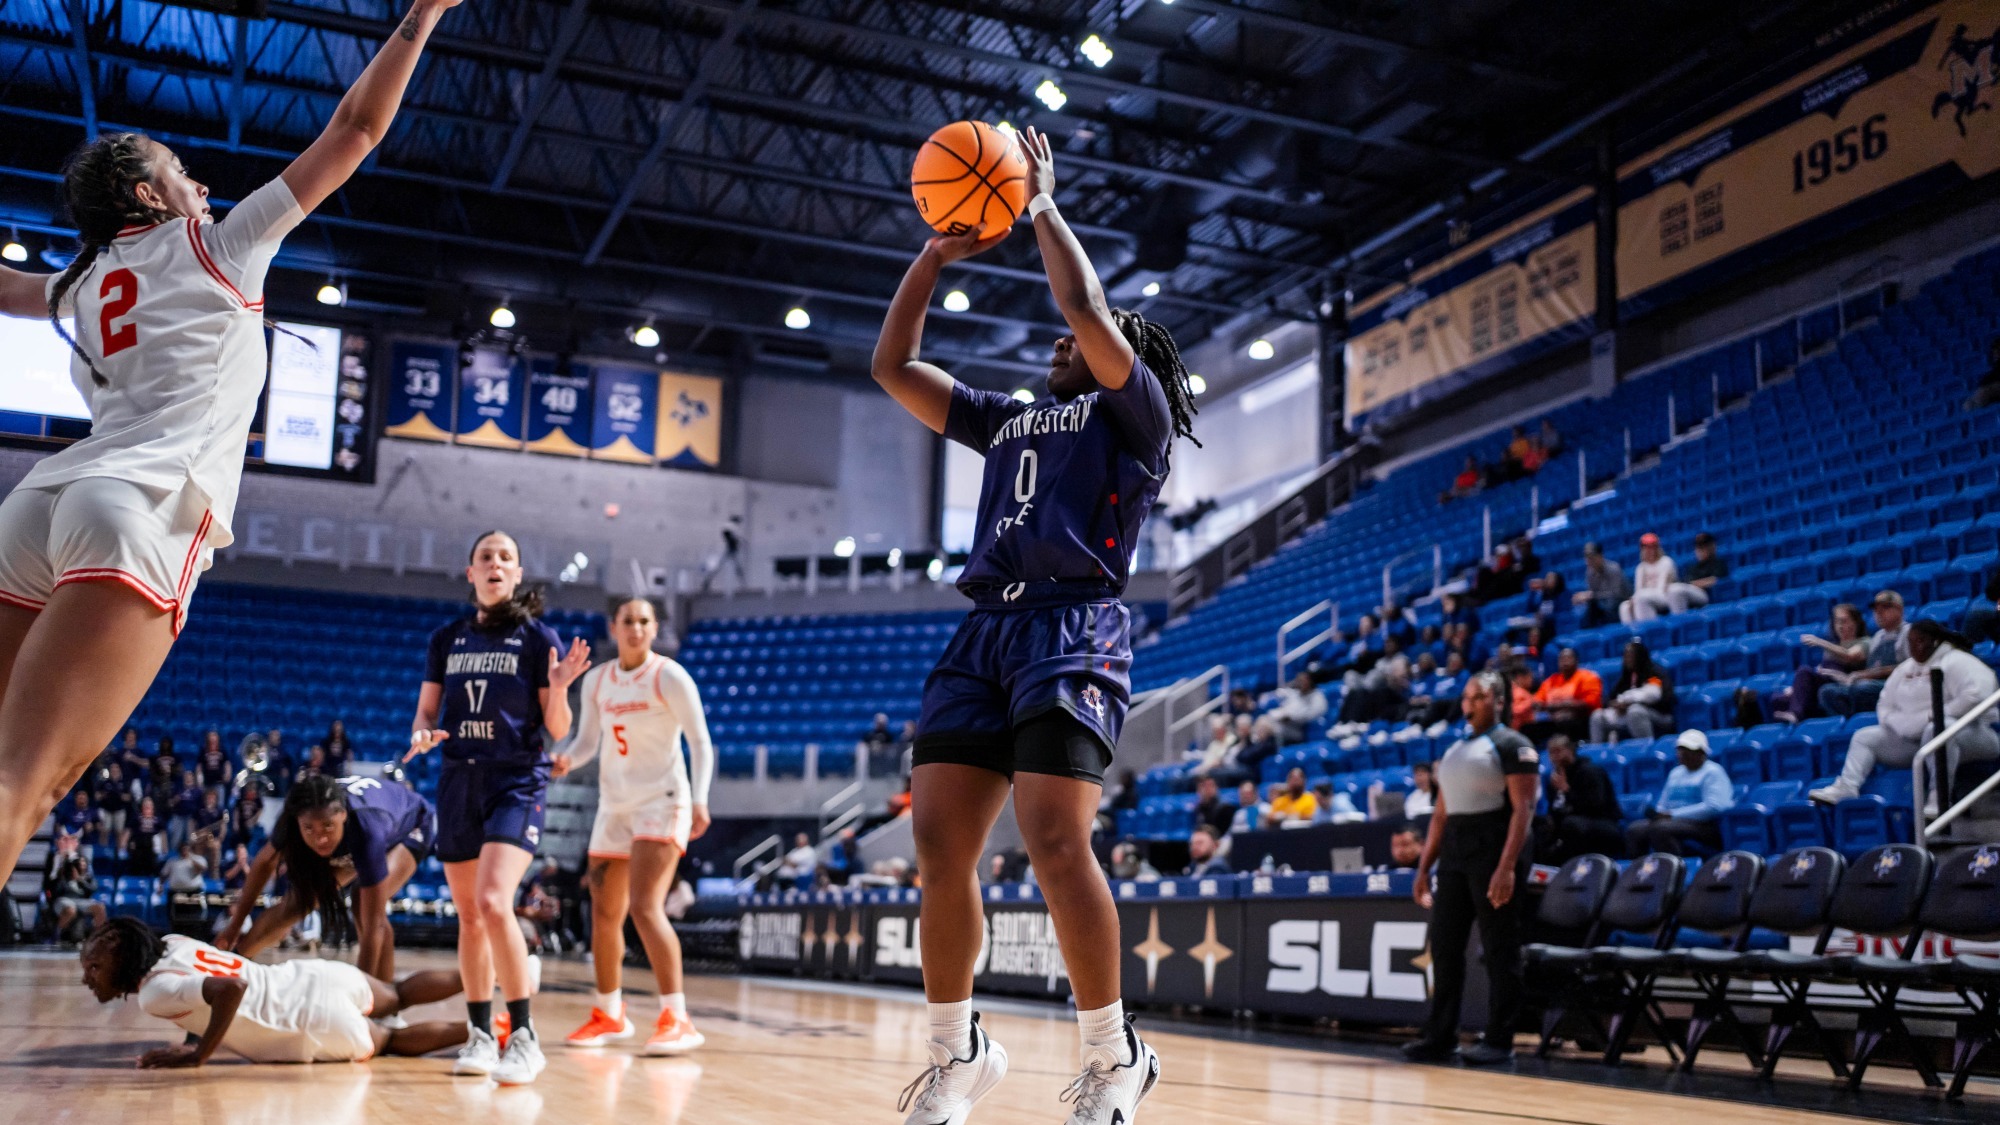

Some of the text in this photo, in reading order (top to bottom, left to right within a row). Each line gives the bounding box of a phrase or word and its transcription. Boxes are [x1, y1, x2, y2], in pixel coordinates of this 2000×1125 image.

[1792, 112, 1889, 193] 1956
[100, 268, 138, 358] 2
[404, 368, 441, 398] 33
[473, 376, 510, 406] 34
[541, 386, 578, 414] 40
[1014, 449, 1038, 503] 0
[464, 680, 488, 713] 17
[458, 720, 495, 739] STATE
[613, 724, 628, 756] 5
[1265, 919, 1429, 1002] SLC
